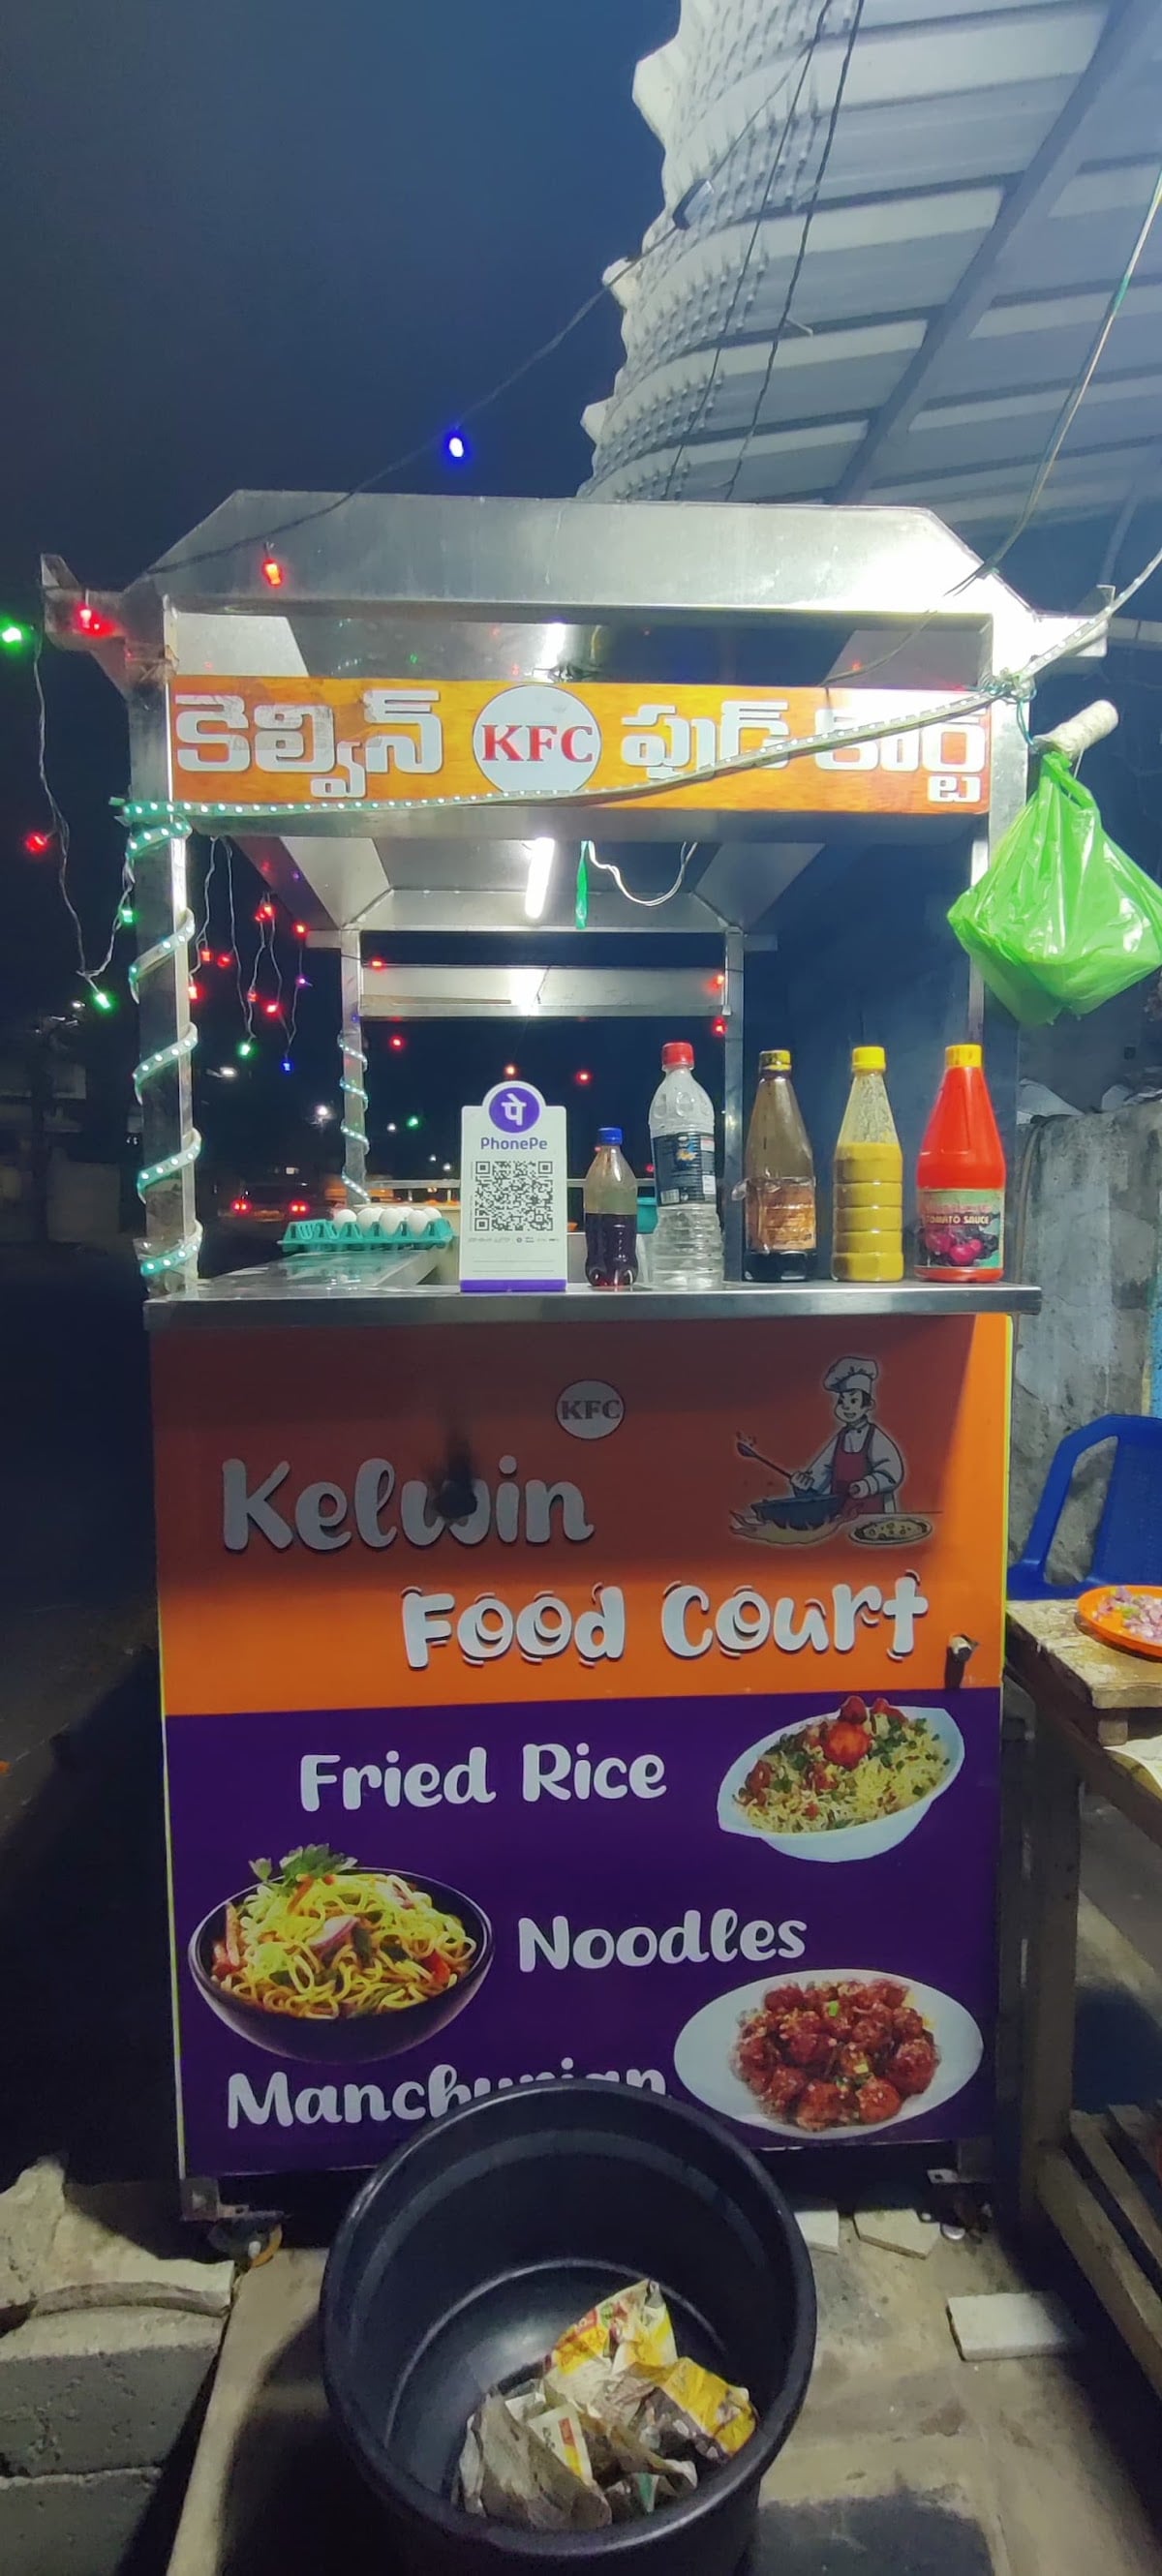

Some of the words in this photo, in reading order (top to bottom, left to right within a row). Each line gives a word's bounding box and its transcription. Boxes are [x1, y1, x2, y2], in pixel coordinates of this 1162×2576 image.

[175, 689, 443, 798] కెల్విన్
[481, 724, 595, 763] KFC
[480, 1136, 548, 1150] PhonePe
[963, 1215, 990, 1225] SAUCE
[561, 1399, 621, 1420] KFC
[222, 1455, 594, 1551] Kelwin
[400, 1583, 627, 1669] Food
[659, 1574, 929, 1661] Court
[300, 1745, 497, 1812] Fried
[522, 1742, 668, 1803] Rice
[518, 1908, 809, 1973] Noodles
